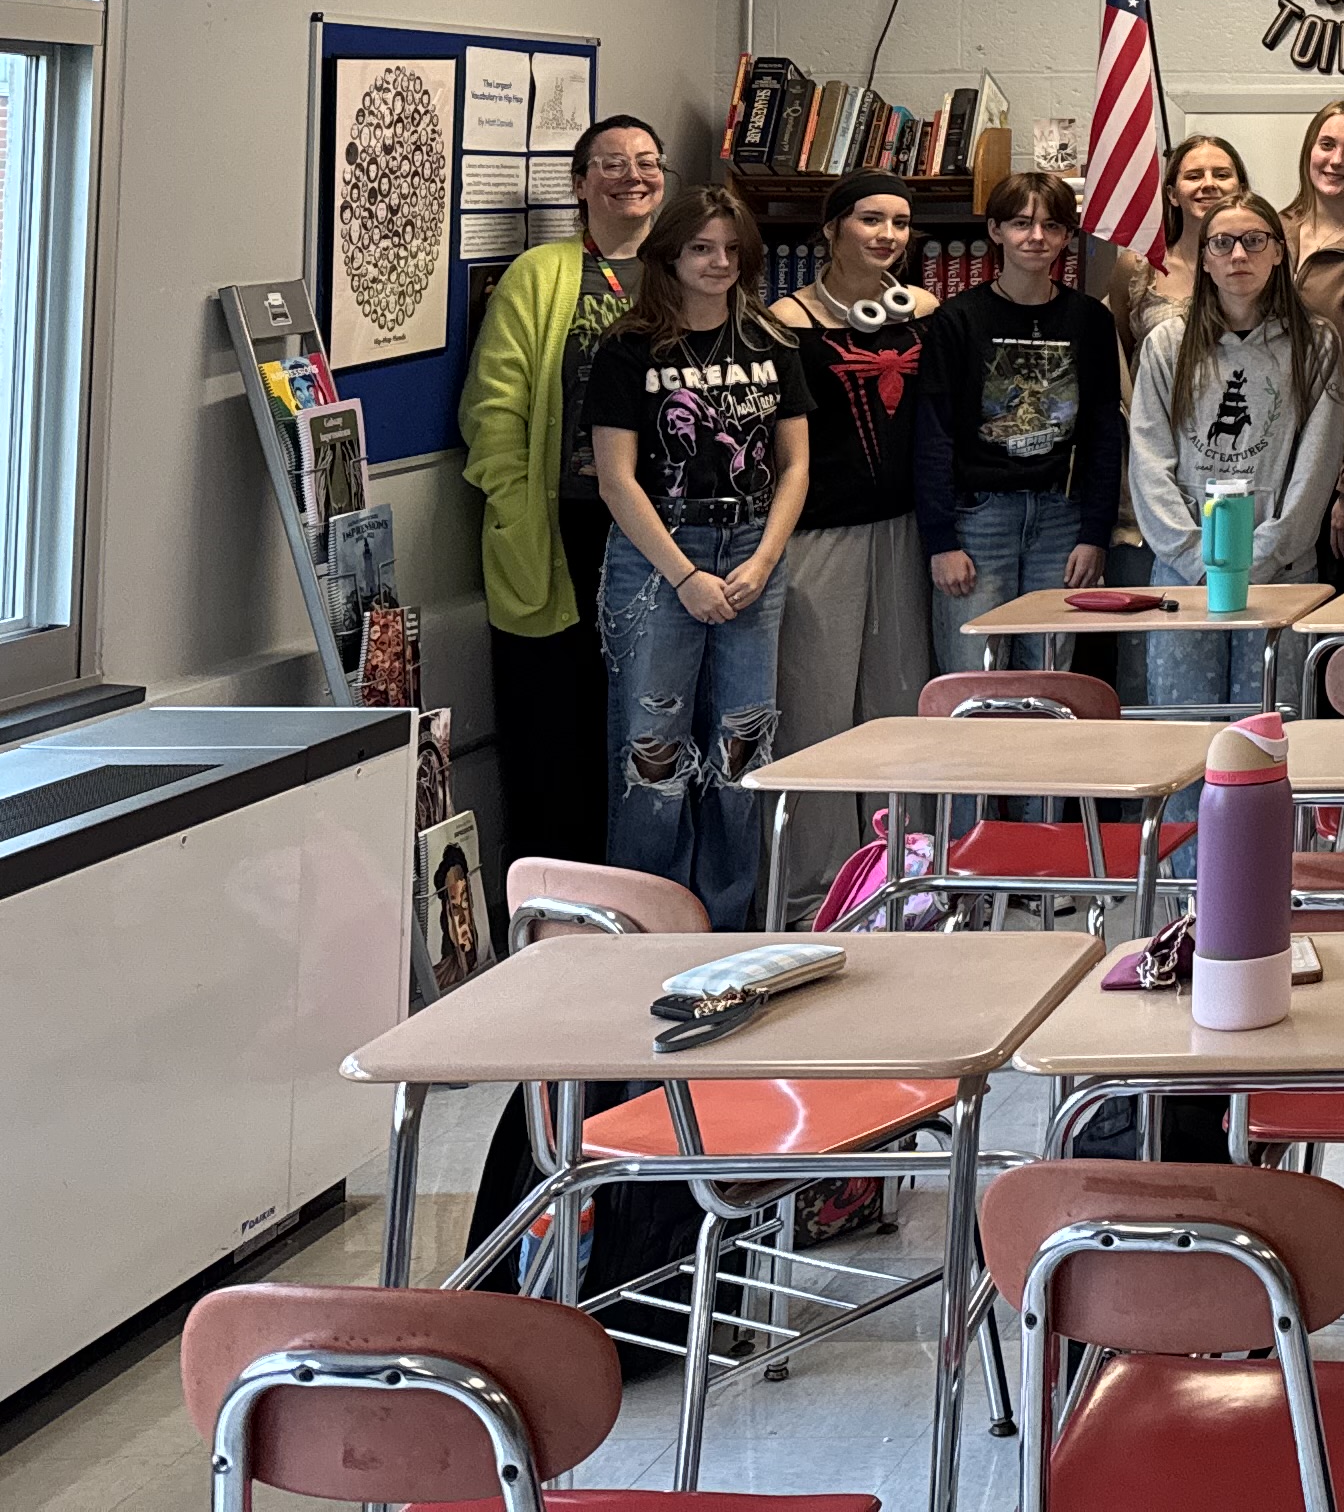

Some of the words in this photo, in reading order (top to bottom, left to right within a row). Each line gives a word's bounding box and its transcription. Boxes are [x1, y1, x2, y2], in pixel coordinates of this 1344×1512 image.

[745, 88, 771, 143] SHAKESPEARE
[645, 360, 779, 394] SCREAM
[1190, 435, 1205, 453] ALL
[248, 1205, 275, 1230] DAIKIN
